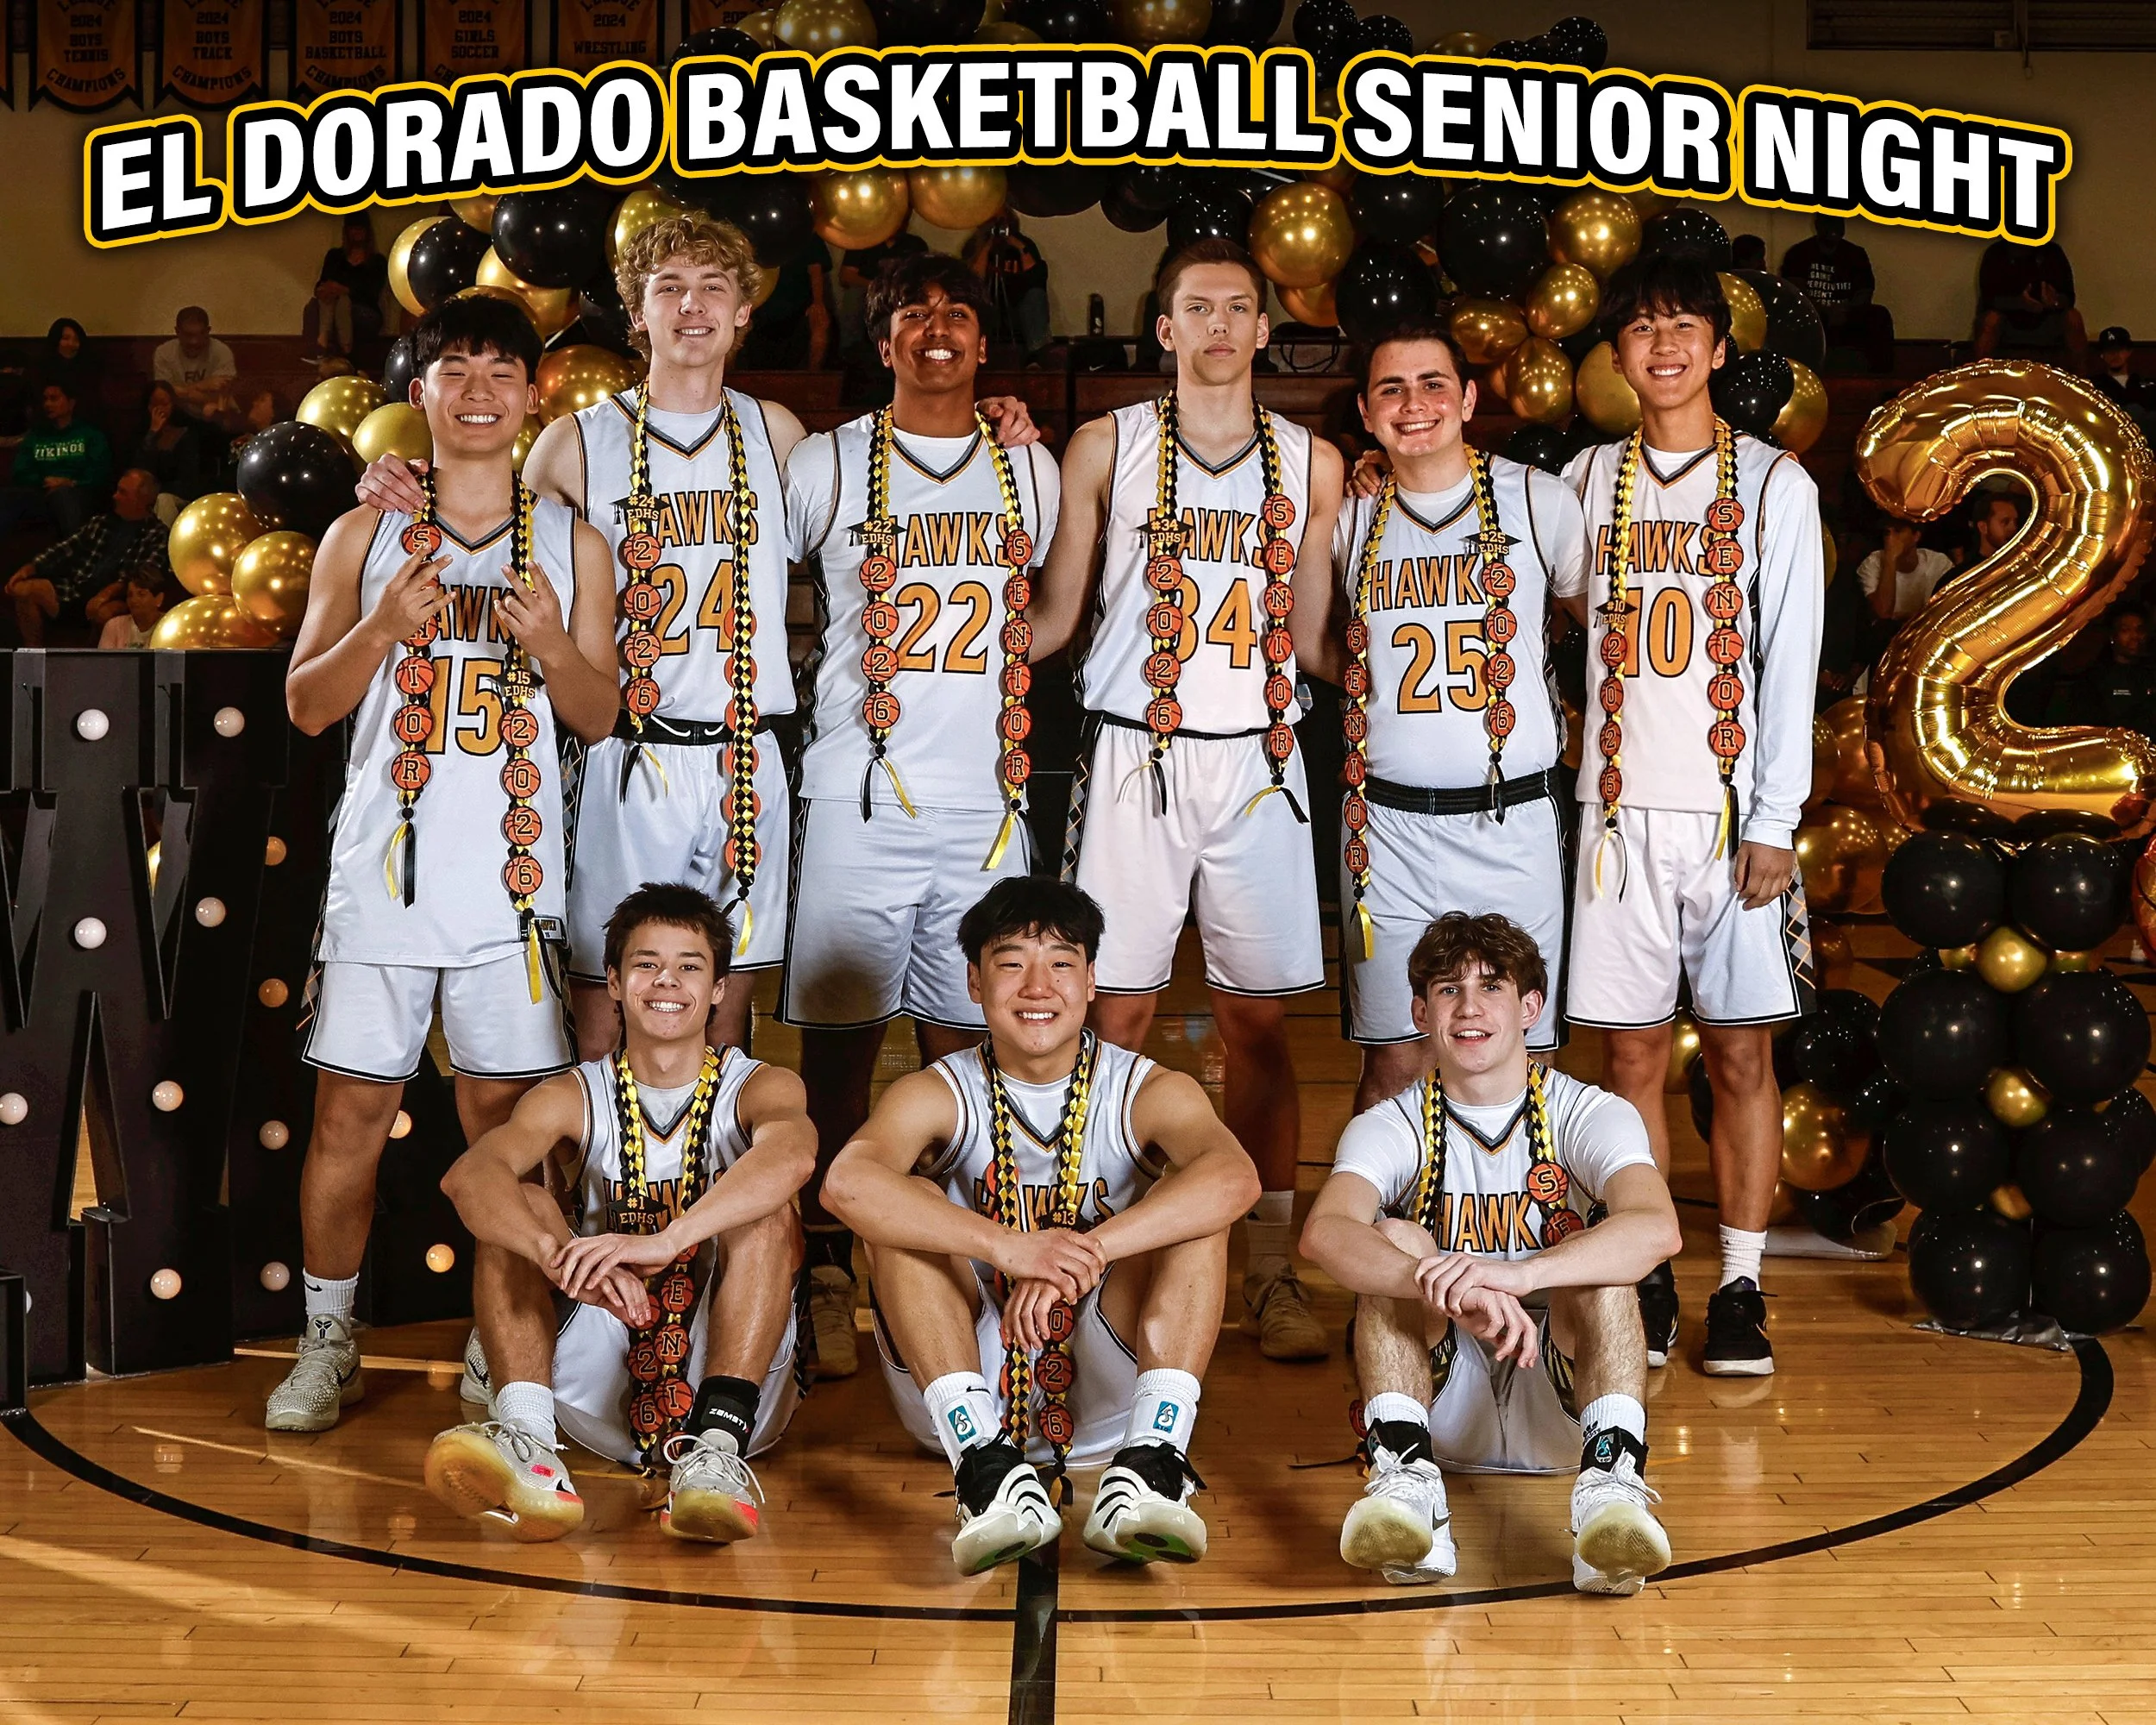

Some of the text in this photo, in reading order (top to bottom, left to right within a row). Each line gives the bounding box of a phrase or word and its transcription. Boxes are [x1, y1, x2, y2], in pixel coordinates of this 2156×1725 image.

[197, 12, 229, 24] 2024
[329, 11, 361, 24] 2024
[458, 10, 492, 23] 2024
[593, 14, 626, 27] 2024
[70, 34, 102, 47] BOYS
[196, 31, 229, 44] BOYS
[329, 30, 362, 43] BOYS
[454, 29, 495, 42] GIRLS
[192, 47, 233, 60] TRACK
[304, 46, 386, 60] BASKETBALL
[451, 45, 498, 59] SOCCER
[573, 41, 647, 54] WRESTLING
[64, 49, 109, 62] TENNIS
[47, 68, 126, 92] CHAMPIONS
[172, 65, 252, 90] CHAMPIONS
[628, 495, 655, 508] #24
[627, 509, 659, 520] EDHS
[863, 520, 893, 533] #22
[1150, 519, 1179, 532] #34
[862, 532, 893, 545] EDHS
[1150, 532, 1181, 544] EDHS
[1479, 531, 1507, 543] #25
[1479, 543, 1509, 555] EDHS
[1369, 553, 1485, 612] HAWK
[649, 558, 735, 656] 24
[1606, 599, 1626, 613] #10
[635, 539, 653, 706] 2026
[1602, 612, 1627, 625] EDHS
[895, 580, 993, 675] 22
[1269, 501, 1288, 754] SENIOR
[1622, 586, 1695, 679] 10
[1713, 503, 1736, 750] SENIOR
[870, 561, 891, 722] 2026
[1155, 562, 1174, 727] 2026
[1490, 569, 1510, 729] 2026
[1011, 536, 1029, 777] SENIOR
[1391, 618, 1489, 715] 25
[506, 670, 531, 686] #15
[505, 686, 536, 699] EDHS
[425, 655, 505, 756] 15
[1604, 637, 1621, 796] 2026
[511, 718, 536, 888] 2026
[627, 1196, 645, 1210] #1
[618, 1212, 655, 1226] EDHS
[1052, 1211, 1077, 1226] #13
[1435, 1190, 1543, 1253] HAWK
[1045, 1308, 1065, 1438] 026
